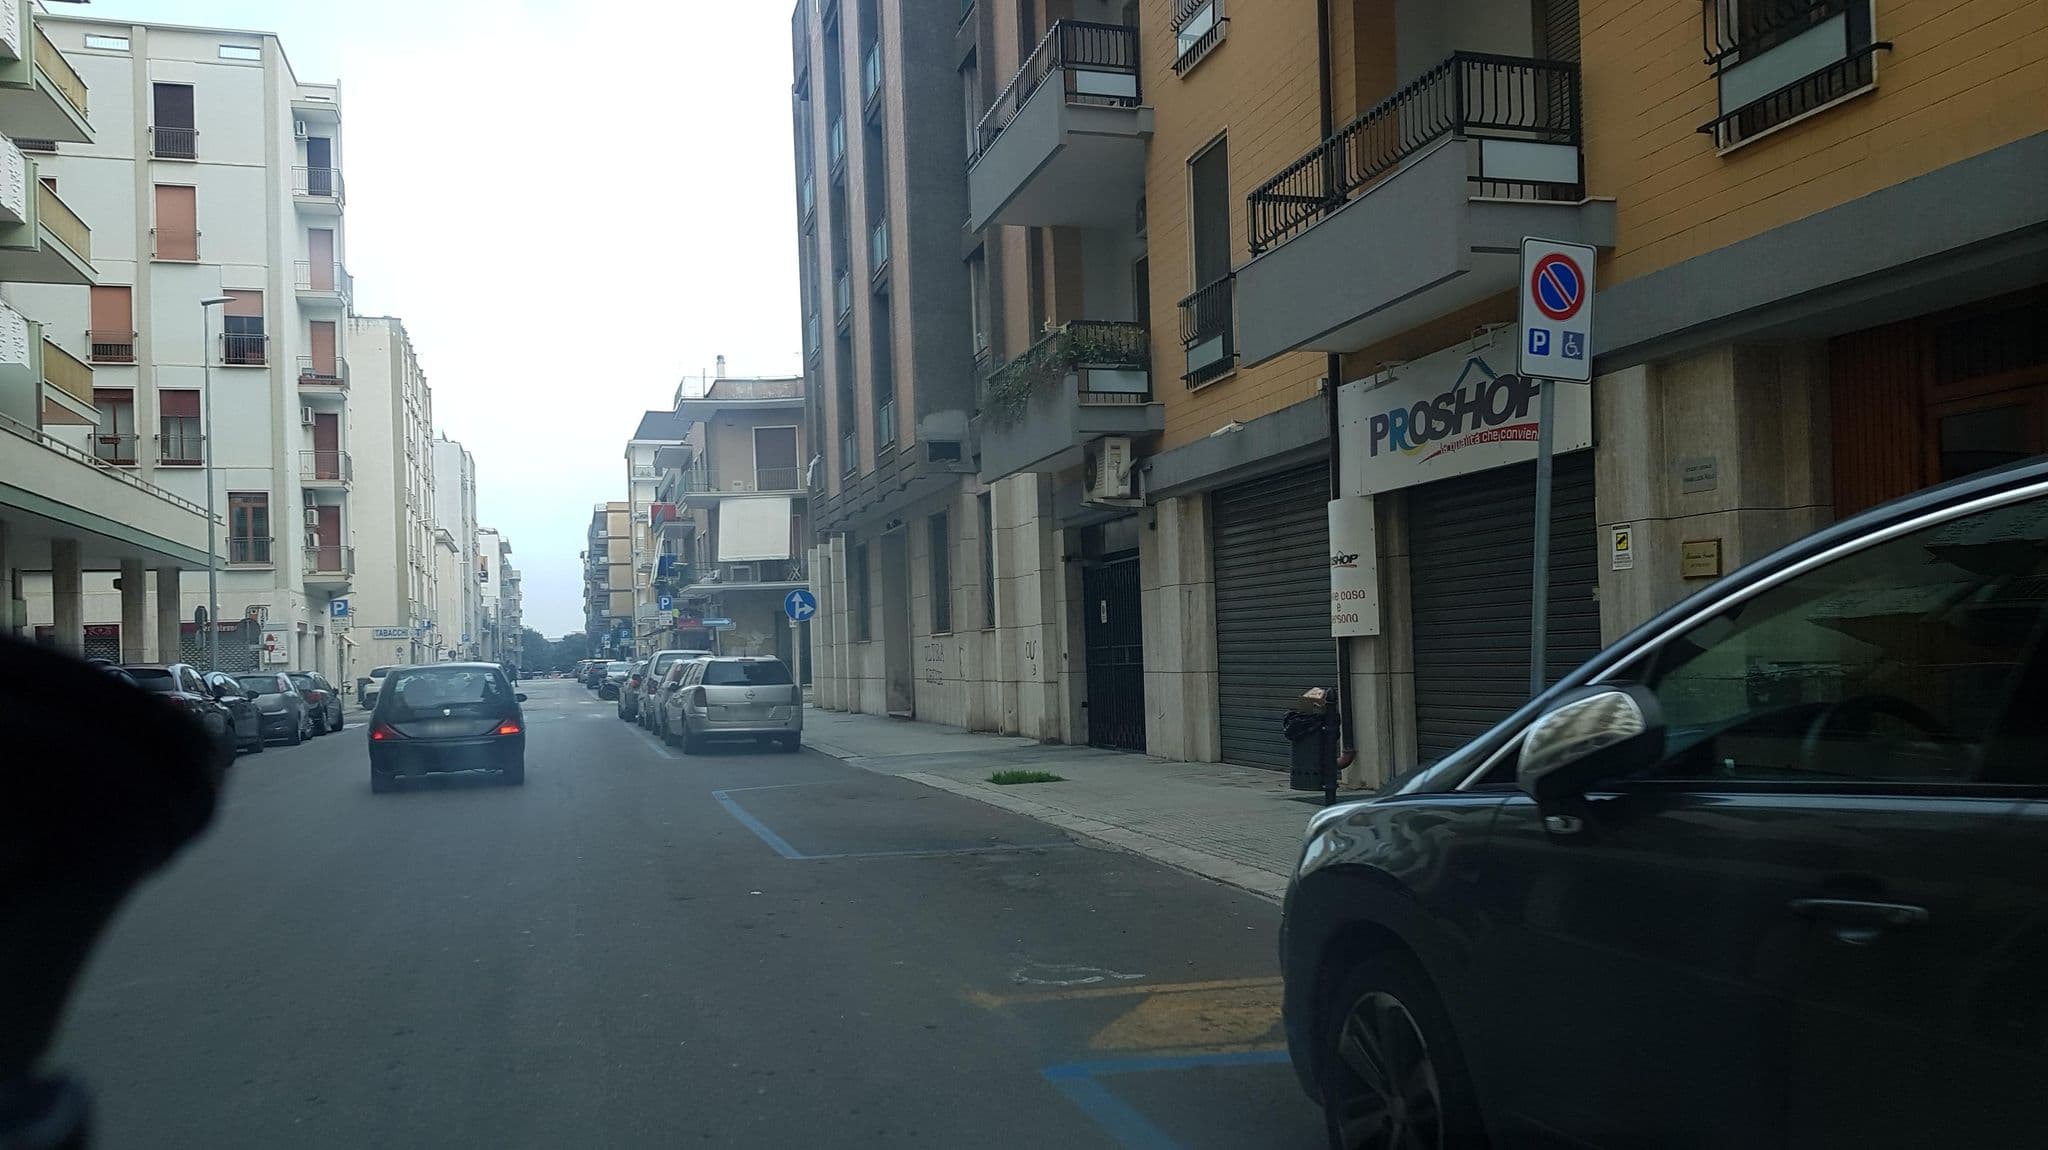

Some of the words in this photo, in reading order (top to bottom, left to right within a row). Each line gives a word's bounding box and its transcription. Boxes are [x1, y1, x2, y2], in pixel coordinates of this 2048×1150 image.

[1533, 331, 1547, 353] P
[1482, 430, 1499, 442] che
[1500, 428, 1538, 441] convien
[1341, 590, 1365, 600] casa
[333, 602, 345, 615] P
[662, 597, 670, 609] P
